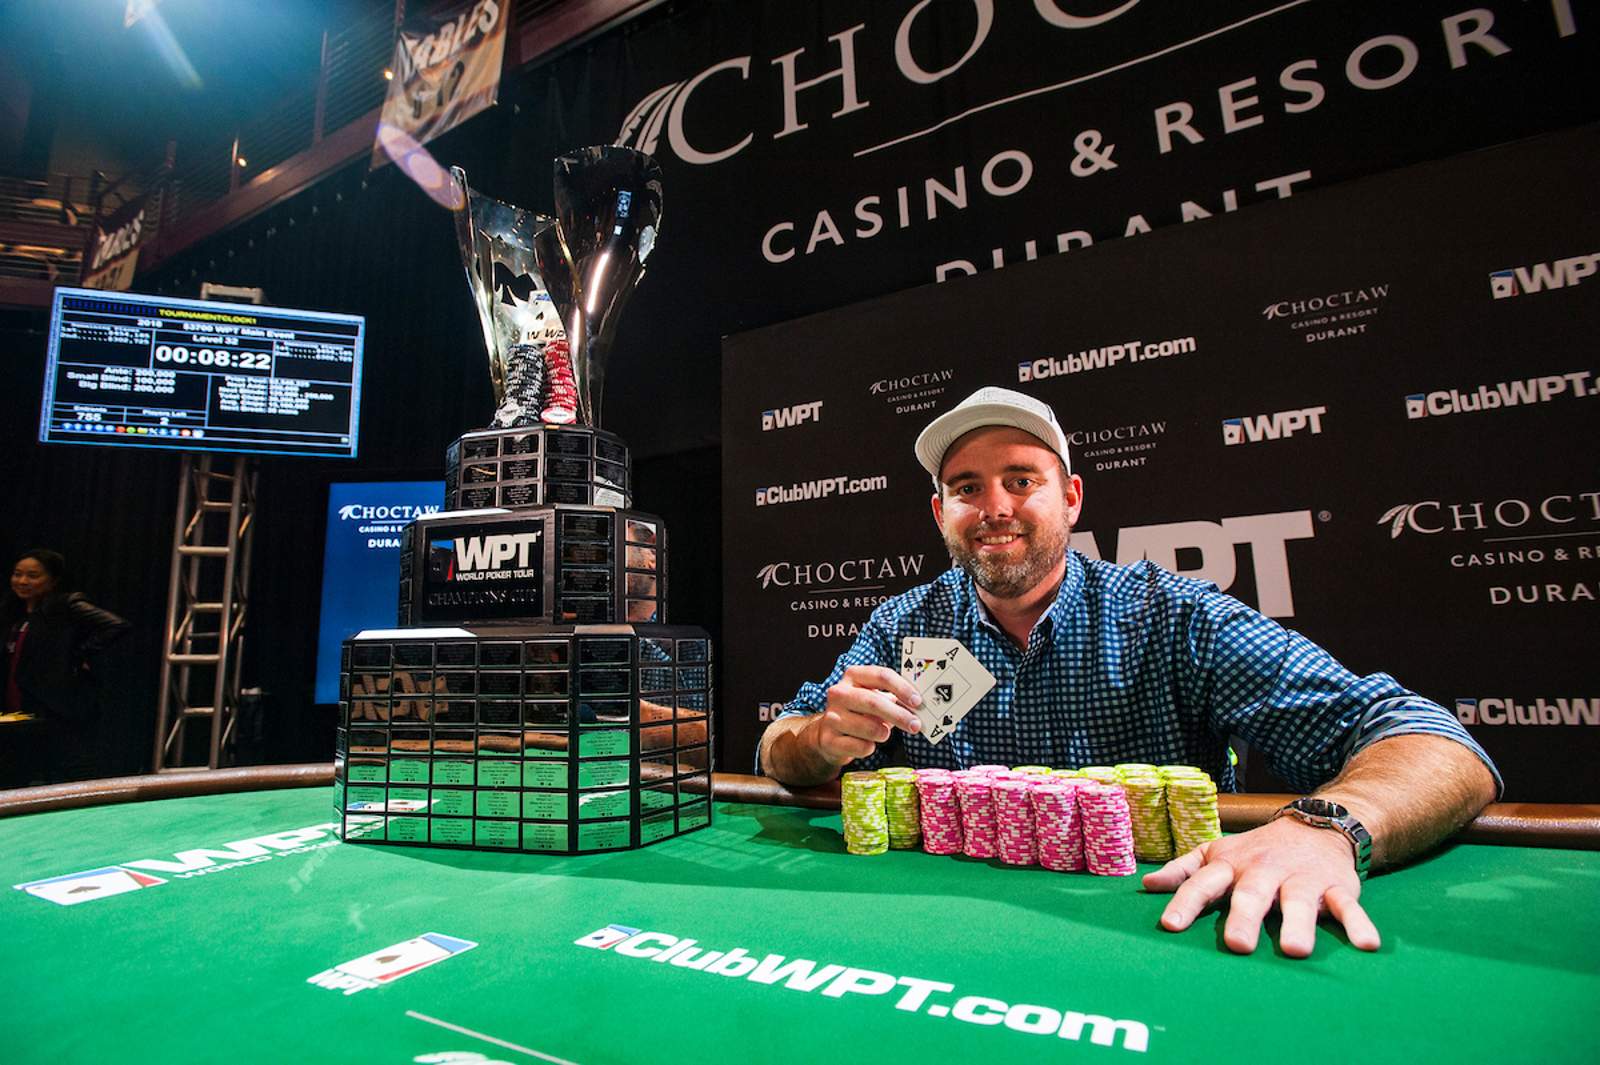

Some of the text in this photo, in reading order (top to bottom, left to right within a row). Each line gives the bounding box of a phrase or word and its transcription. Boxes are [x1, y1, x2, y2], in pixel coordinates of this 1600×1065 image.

[668, 0, 1141, 164] CHO
[762, 150, 1033, 263] CASINO
[1070, 130, 1119, 178] &
[1514, 253, 1600, 295] WP
[1275, 284, 1390, 317] CHOCTAW
[1291, 317, 1328, 329] CASINO
[1339, 308, 1378, 321] RESORT
[193, 334, 239, 346] Level 32
[240, 327, 265, 338] Main
[267, 329, 295, 340] Event
[1306, 324, 1367, 342] DURANT
[155, 346, 271, 370] 00:08:22
[1032, 336, 1197, 379] ClubWPT.com
[67, 371, 100, 382] Small
[103, 374, 132, 385] Blind:
[104, 366, 133, 377] Ante:
[78, 380, 100, 392] Big
[103, 381, 132, 392] Blind:
[876, 369, 954, 394] CHOCTAW
[888, 393, 912, 403] CASINO
[919, 388, 945, 398] RESORT
[1426, 371, 1600, 416] ClubWPT.
[775, 401, 823, 428] WPT
[896, 401, 937, 414] DURANT
[1071, 421, 1167, 446] CHOCTAW
[1242, 406, 1327, 442] WPT
[1084, 447, 1116, 458] CASINO
[1124, 442, 1157, 452] RESORT
[1096, 457, 1147, 471] DURANT
[766, 475, 887, 505] ClubWPT.com
[349, 504, 440, 520] CHOCTAW
[358, 526, 388, 534] CASINO
[367, 538, 401, 548] DURA
[455, 533, 537, 570] WPT
[1451, 550, 1545, 567] CASINO
[1554, 548, 1569, 561] &
[456, 569, 534, 582] WORLD POKER TOUR
[772, 554, 925, 586] CHOCTAW
[791, 595, 895, 611] CASINO & RESO
[1489, 583, 1600, 605] DURA
[807, 623, 863, 638] DURA
[905, 641, 914, 655] J
[945, 647, 959, 661] A
[930, 725, 944, 738] A
[121, 823, 343, 873] WP
[173, 856, 272, 878] WORLD
[614, 932, 1150, 1053] ClubWPT.com
